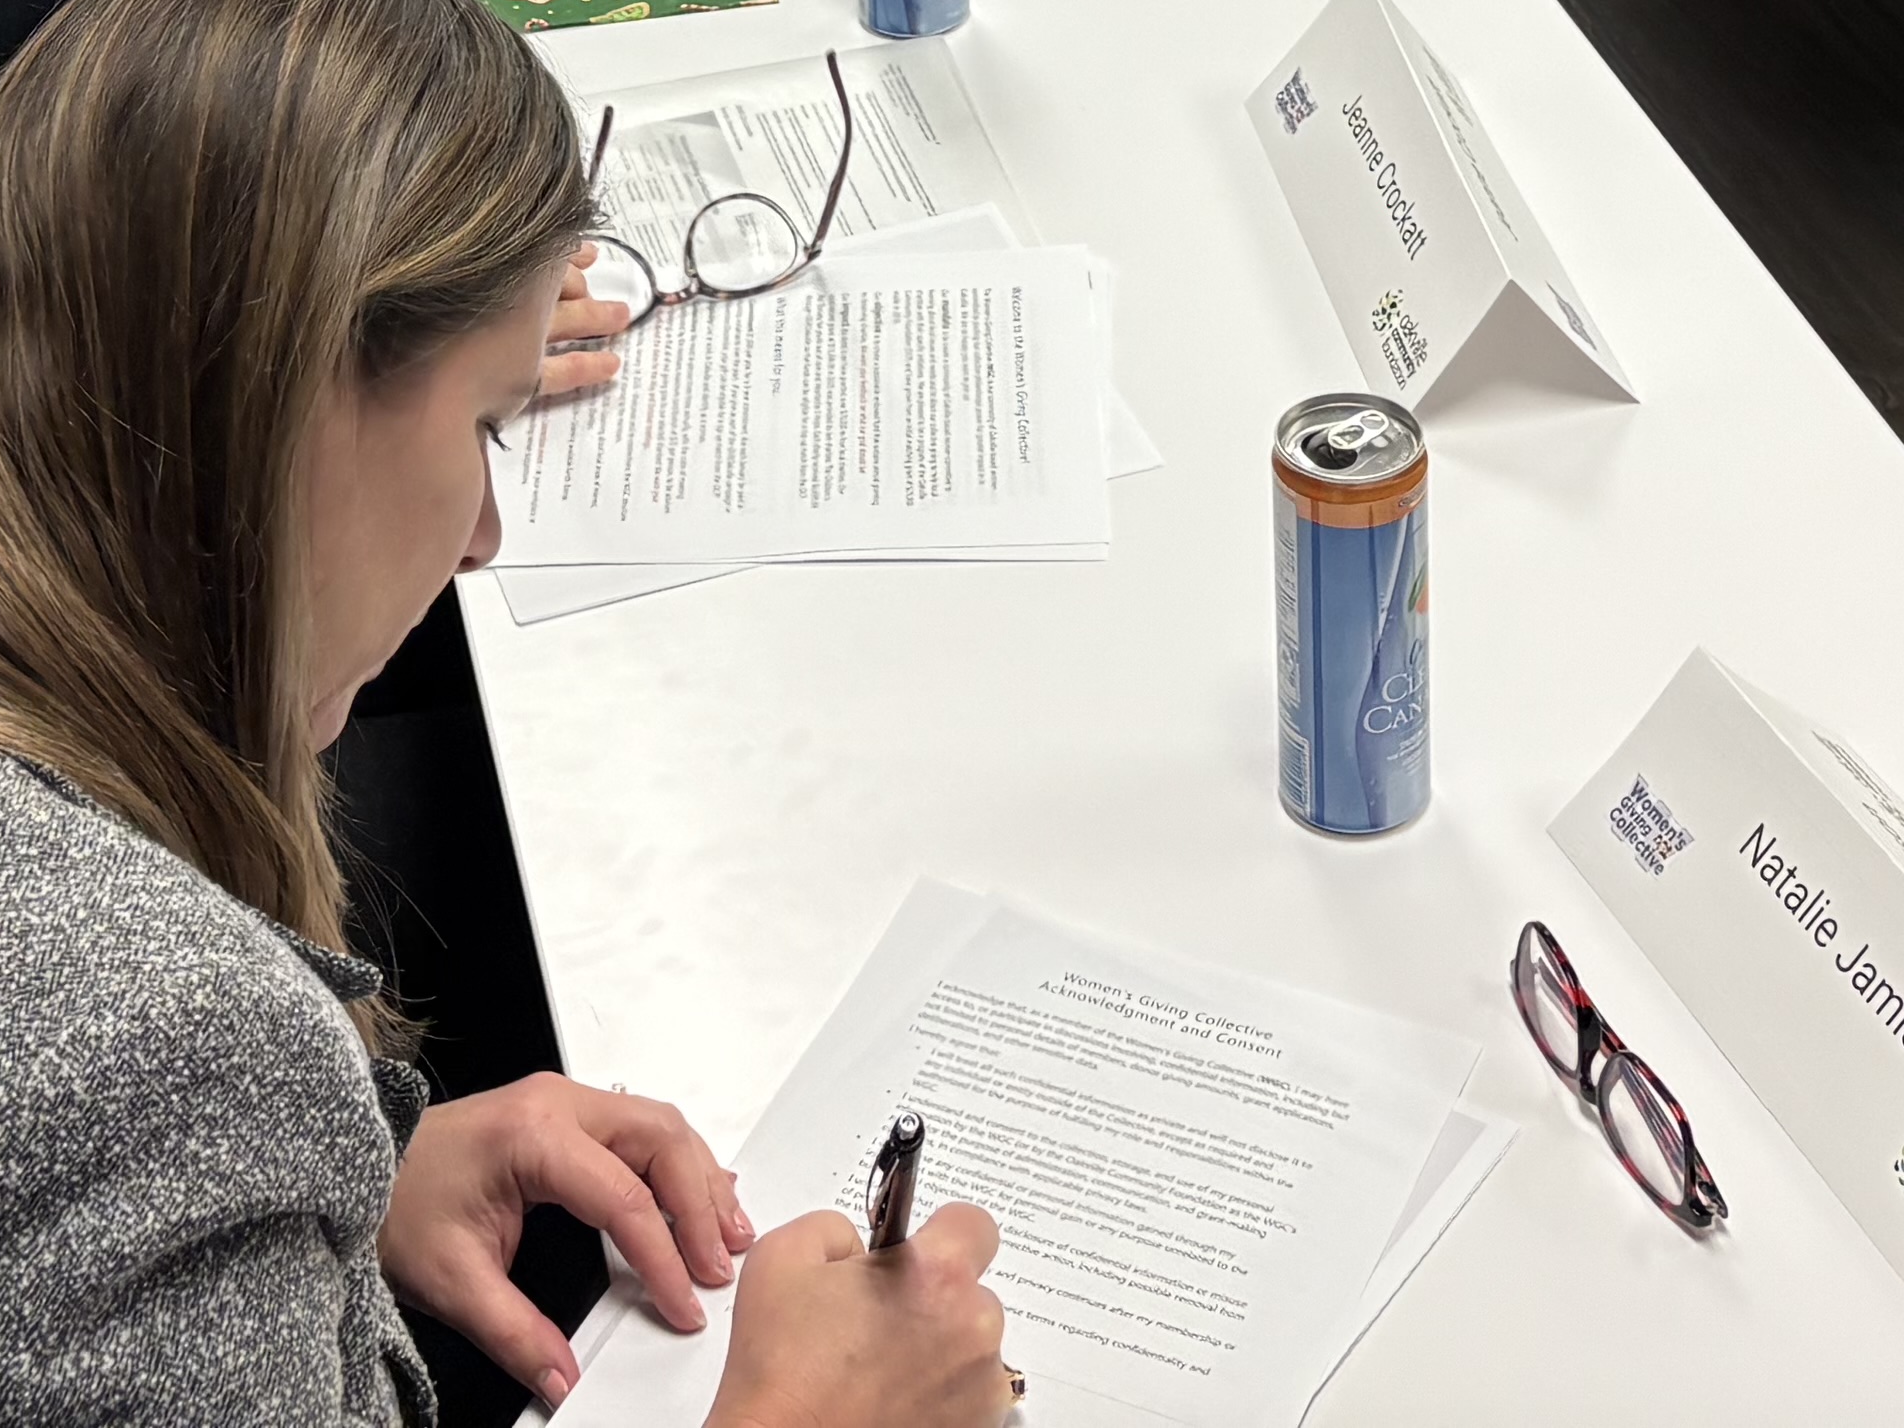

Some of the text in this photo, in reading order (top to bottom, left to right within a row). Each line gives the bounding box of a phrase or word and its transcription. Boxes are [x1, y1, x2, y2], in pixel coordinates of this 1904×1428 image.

[1342, 94, 1428, 262] Jeanne Crockatt
[1609, 807, 1665, 876] Collective
[1620, 796, 1653, 837] Giving
[1630, 780, 1687, 852] Women's
[1739, 822, 1838, 948] Natalie
[1039, 981, 1281, 1058] Acknowledgment and Consent
[1064, 972, 1272, 1039] Women's Giving Collective
[964, 1113, 985, 1124] and
[1209, 1189, 1226, 1200] my
[950, 1177, 968, 1187] the
[970, 1182, 996, 1196] WGC
[998, 1191, 1013, 1201] for
[1013, 1198, 1059, 1216] personal
[989, 1202, 1006, 1212] the
[1028, 1189, 1074, 1207] personal
[1218, 1249, 1236, 1260] my
[995, 1270, 1016, 1281] and
[1136, 1315, 1153, 1326] my
[1133, 1268, 1194, 1291] information
[1189, 1365, 1211, 1375] and
